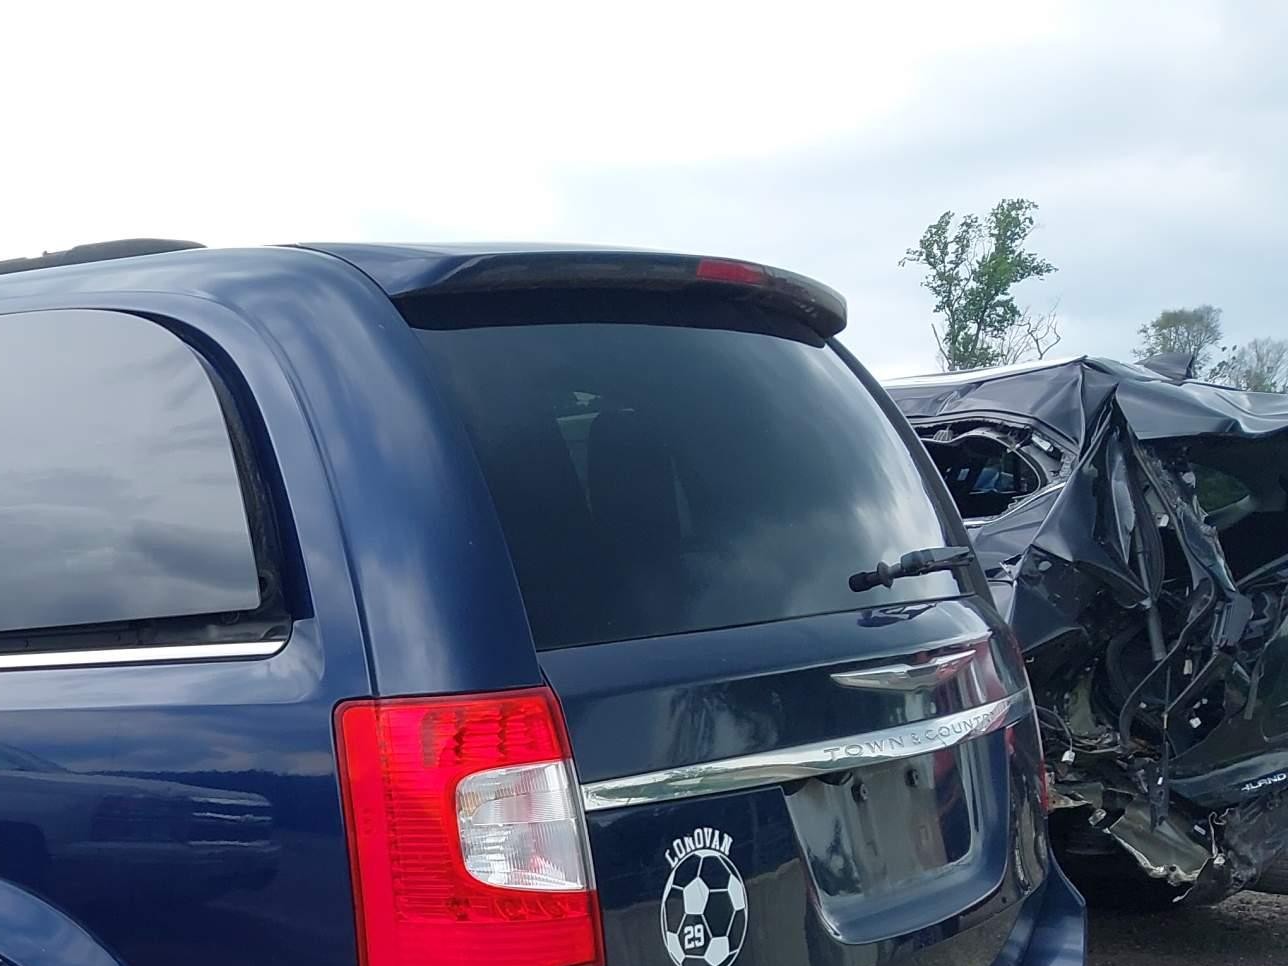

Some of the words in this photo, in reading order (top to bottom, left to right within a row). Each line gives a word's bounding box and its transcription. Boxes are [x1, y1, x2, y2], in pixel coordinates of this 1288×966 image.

[824, 735, 904, 760] TOWN
[911, 732, 922, 745] &
[684, 924, 704, 949] 29
